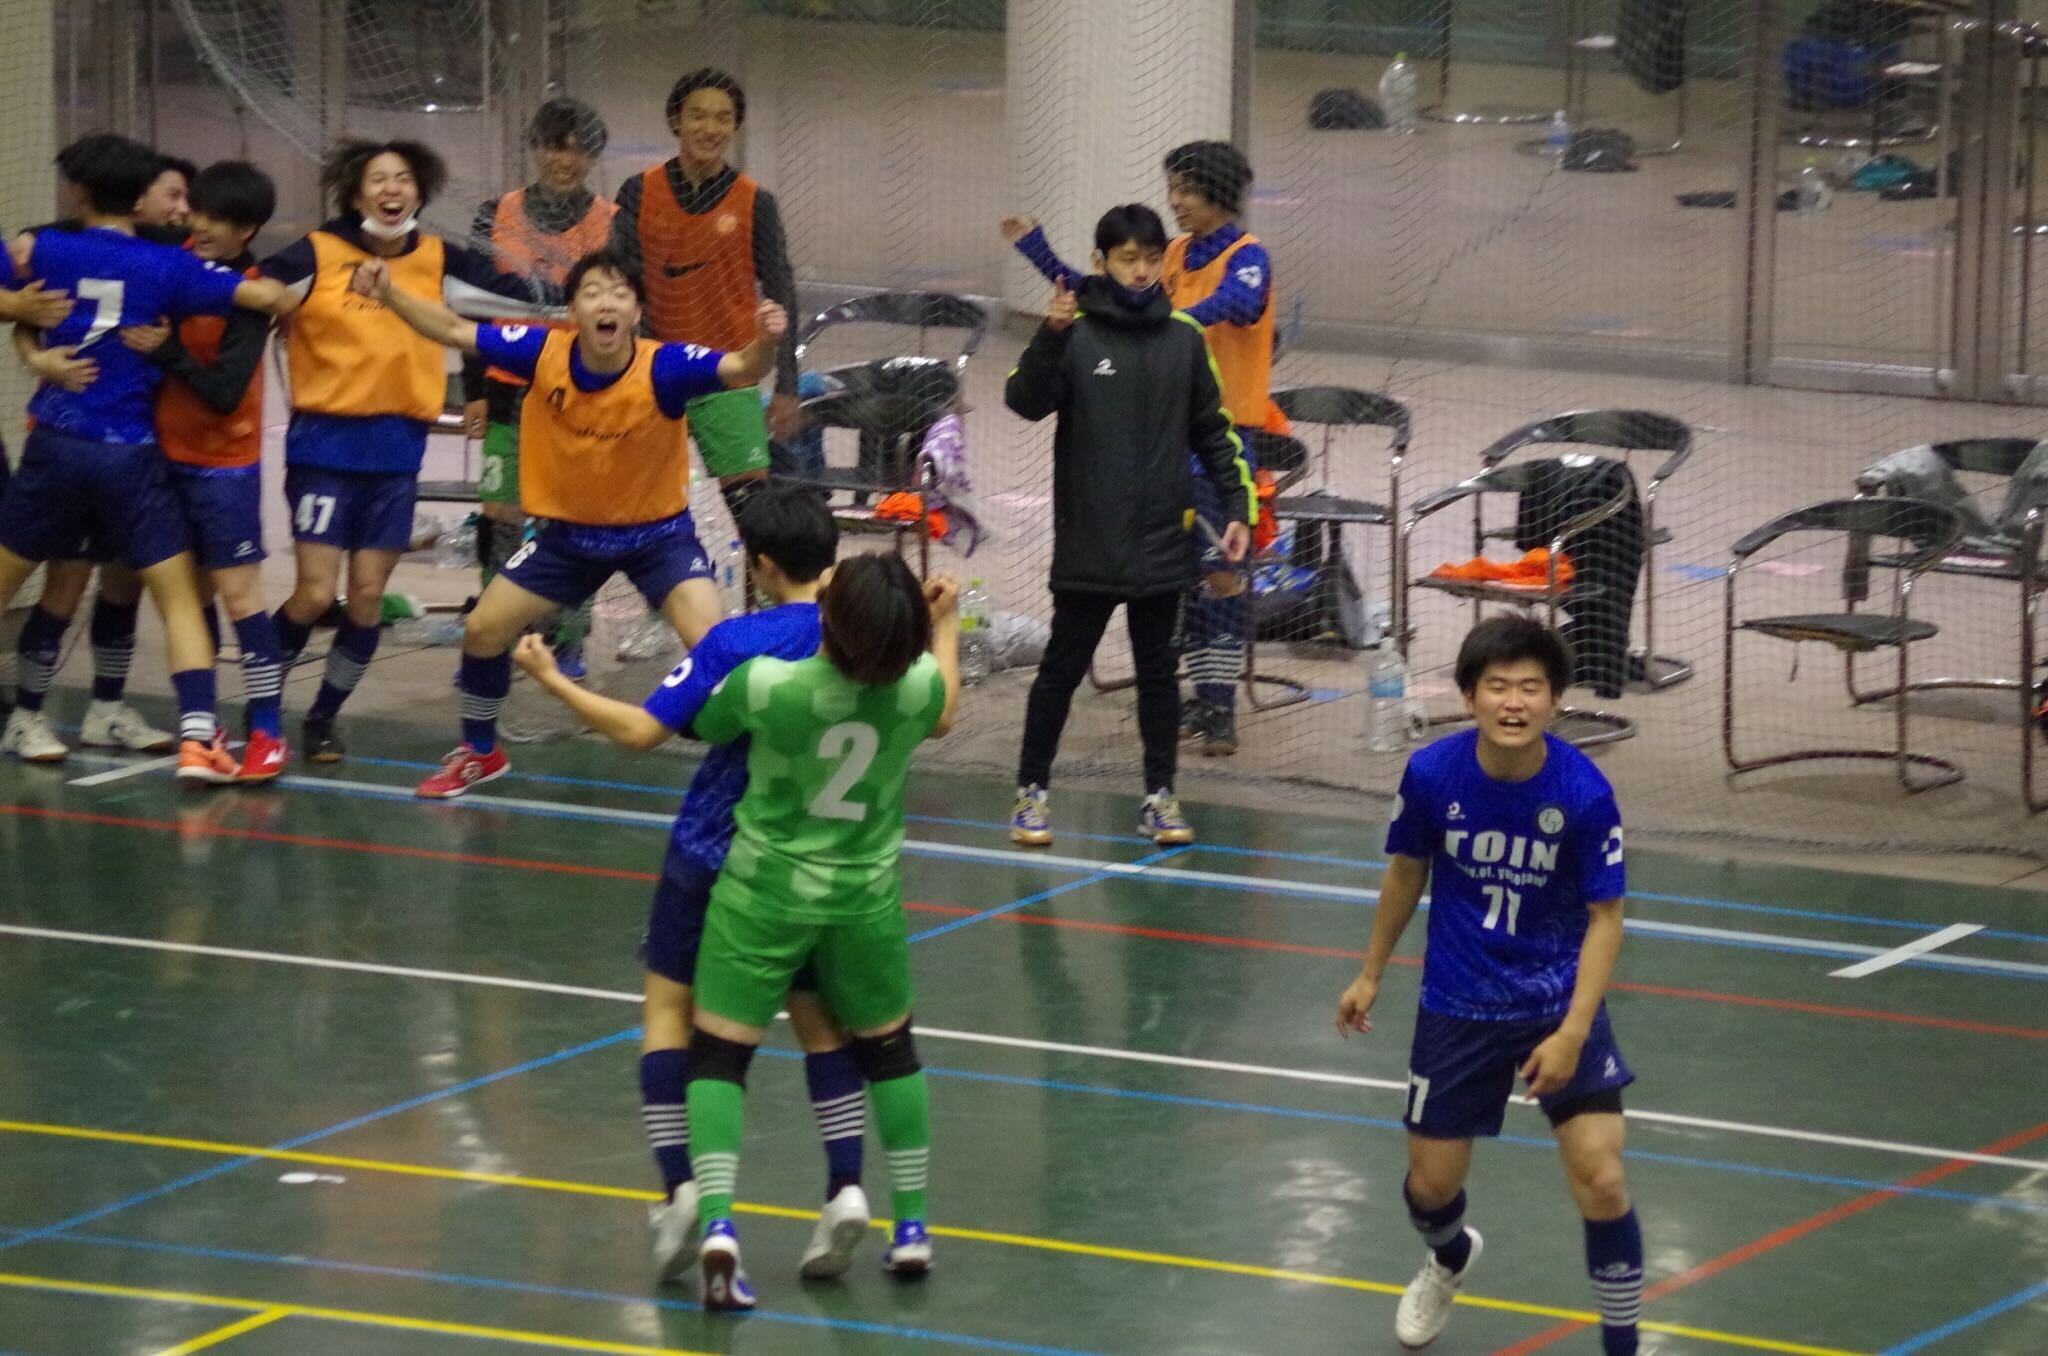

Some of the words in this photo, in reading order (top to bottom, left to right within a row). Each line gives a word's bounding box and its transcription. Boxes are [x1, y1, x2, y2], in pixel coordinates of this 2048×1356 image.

[77, 277, 125, 351] 7
[295, 492, 337, 534] 47
[808, 721, 879, 822] 2
[1445, 829, 1560, 871] TOIN
[1408, 1068, 1431, 1124] 7
